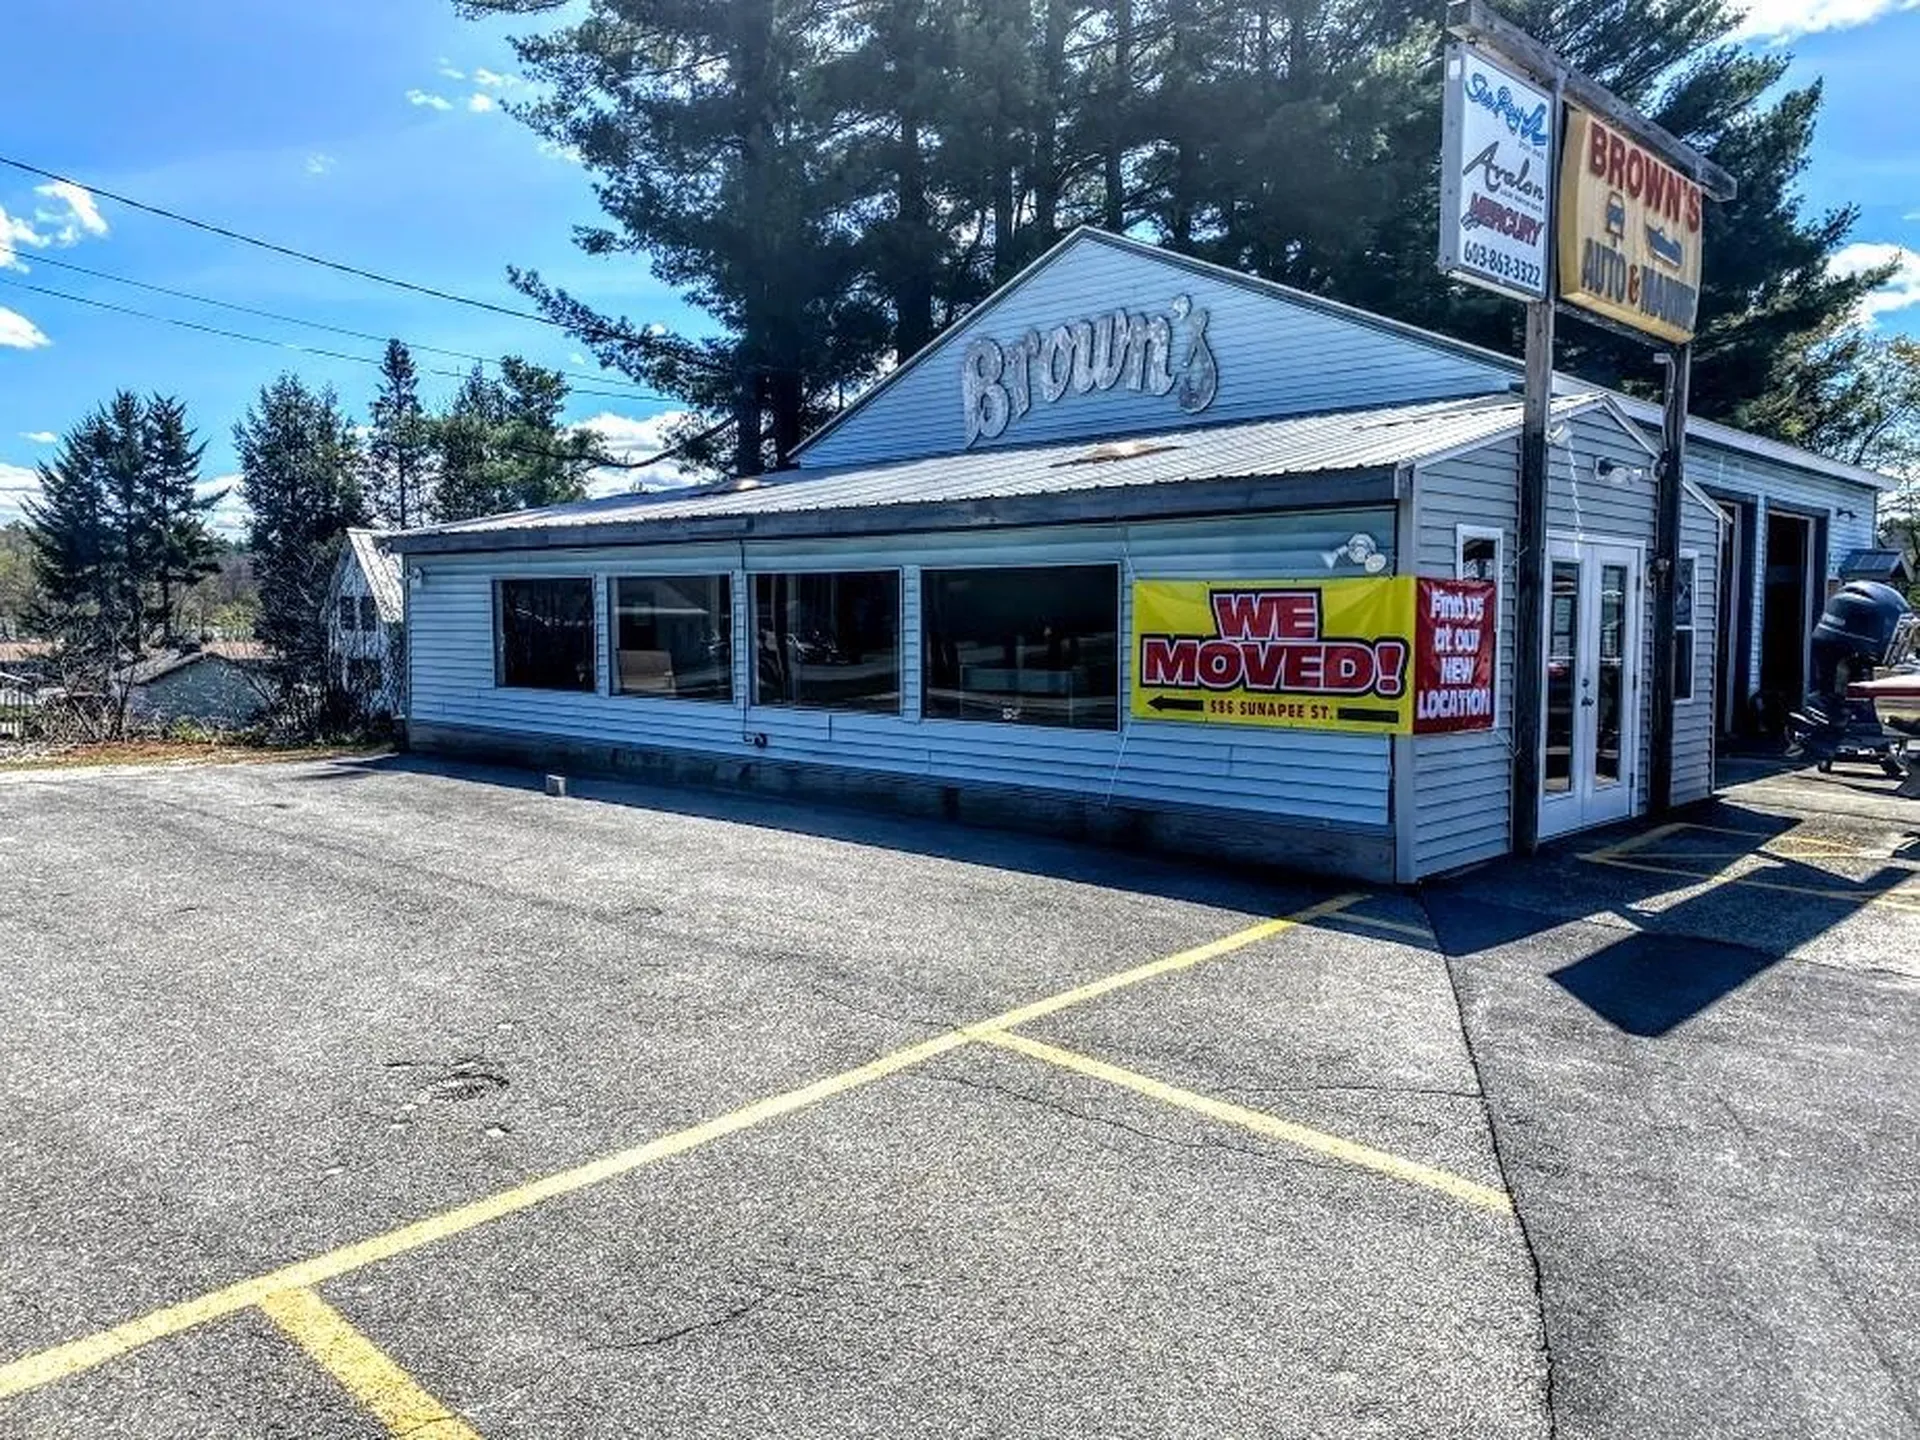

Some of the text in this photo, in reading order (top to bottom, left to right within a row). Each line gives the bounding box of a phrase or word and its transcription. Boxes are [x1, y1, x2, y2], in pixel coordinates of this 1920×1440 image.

[1462, 140, 1545, 202] Avalon
[1589, 122, 1699, 233] BROWN'S
[1464, 240, 1541, 287] 603-863-3322
[1581, 237, 1626, 303] AUTO
[1628, 264, 1640, 304] &
[963, 294, 1218, 449] Brown's
[1210, 591, 1321, 640] WE
[1142, 639, 1405, 695] MOVED!
[1440, 656, 1475, 684] NEW
[1239, 701, 1305, 718] SUNAPEE
[1310, 704, 1333, 719] ST.
[1417, 688, 1490, 719] LOCATION
